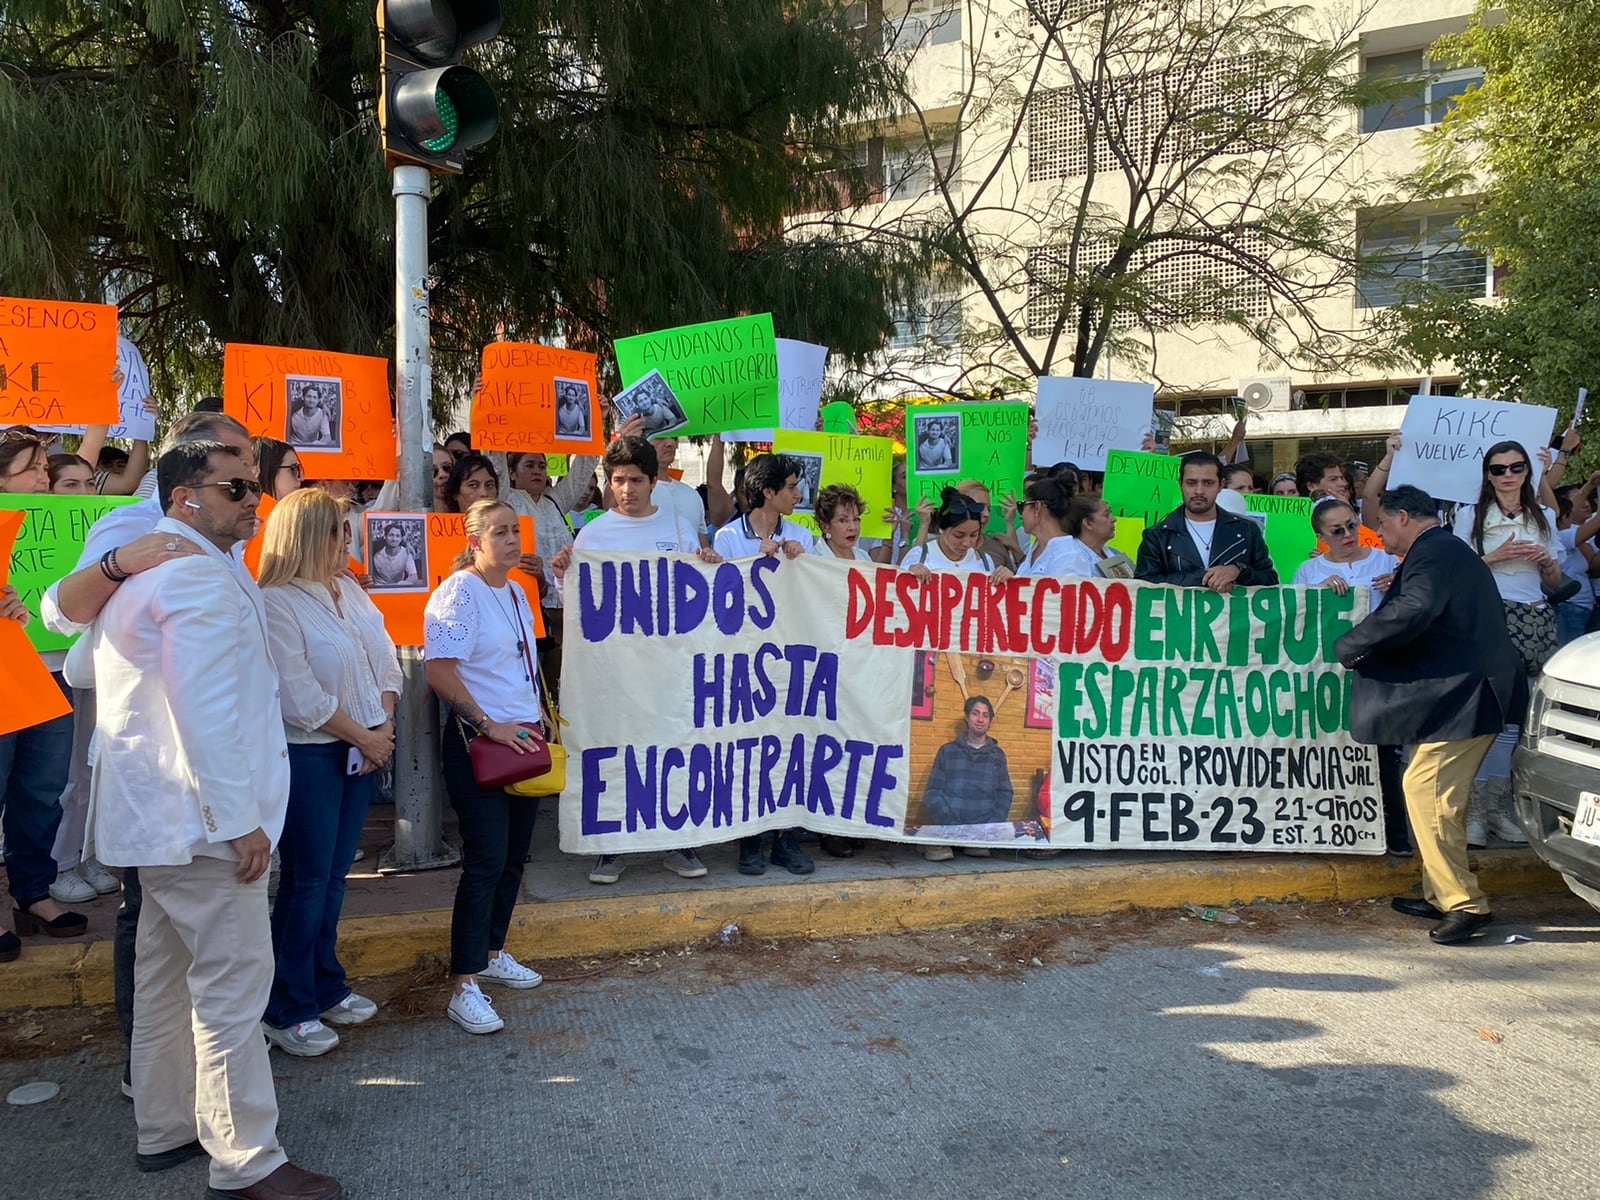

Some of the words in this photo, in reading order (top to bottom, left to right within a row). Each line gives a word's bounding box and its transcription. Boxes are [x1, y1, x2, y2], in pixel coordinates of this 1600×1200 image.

[643, 325, 743, 365] AYUDANOS
[751, 322, 765, 349] A
[233, 350, 251, 378] TE
[483, 348, 580, 375] QUEREMOS
[583, 358, 594, 376] A
[702, 385, 773, 425] KIKE
[487, 413, 509, 426] DE
[1433, 407, 1511, 439] KIKE
[475, 430, 555, 449] REGRESO
[828, 435, 844, 461] TU
[986, 429, 1013, 443] NOS
[988, 448, 1001, 466] A
[1415, 441, 1469, 462] VUELVE
[1150, 484, 1161, 503] A
[578, 555, 781, 643] UNIDOS
[845, 567, 1132, 663] DESAPARECIDO
[693, 642, 839, 728] HASTA
[1057, 740, 1135, 786] VISTO
[1140, 743, 1165, 763] EN
[1342, 745, 1372, 763] GDL
[1137, 764, 1177, 786] COL.
[1178, 744, 1346, 791] PROVIDENCIA
[1345, 765, 1375, 787] JAL
[581, 733, 904, 837] ENCONTRARTE
